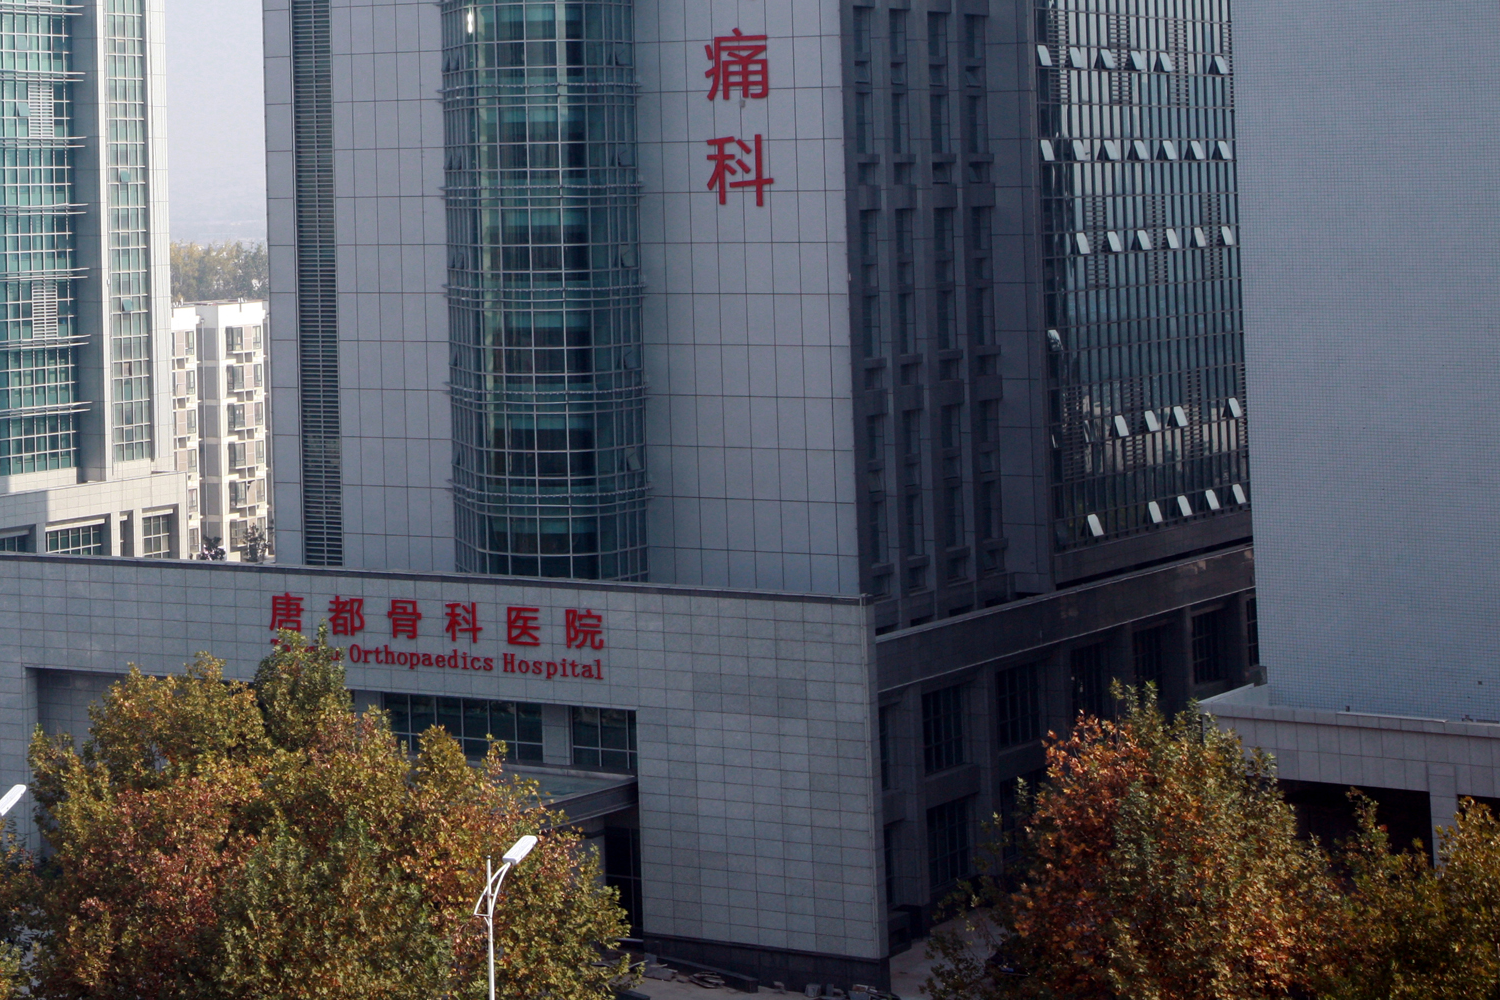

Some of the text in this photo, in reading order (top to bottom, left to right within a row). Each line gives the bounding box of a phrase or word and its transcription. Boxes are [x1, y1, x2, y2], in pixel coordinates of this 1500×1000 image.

[269, 592, 605, 650] 唐都骨科医院
[349, 643, 494, 671] Orthopaedics
[502, 652, 605, 681] Hospital
